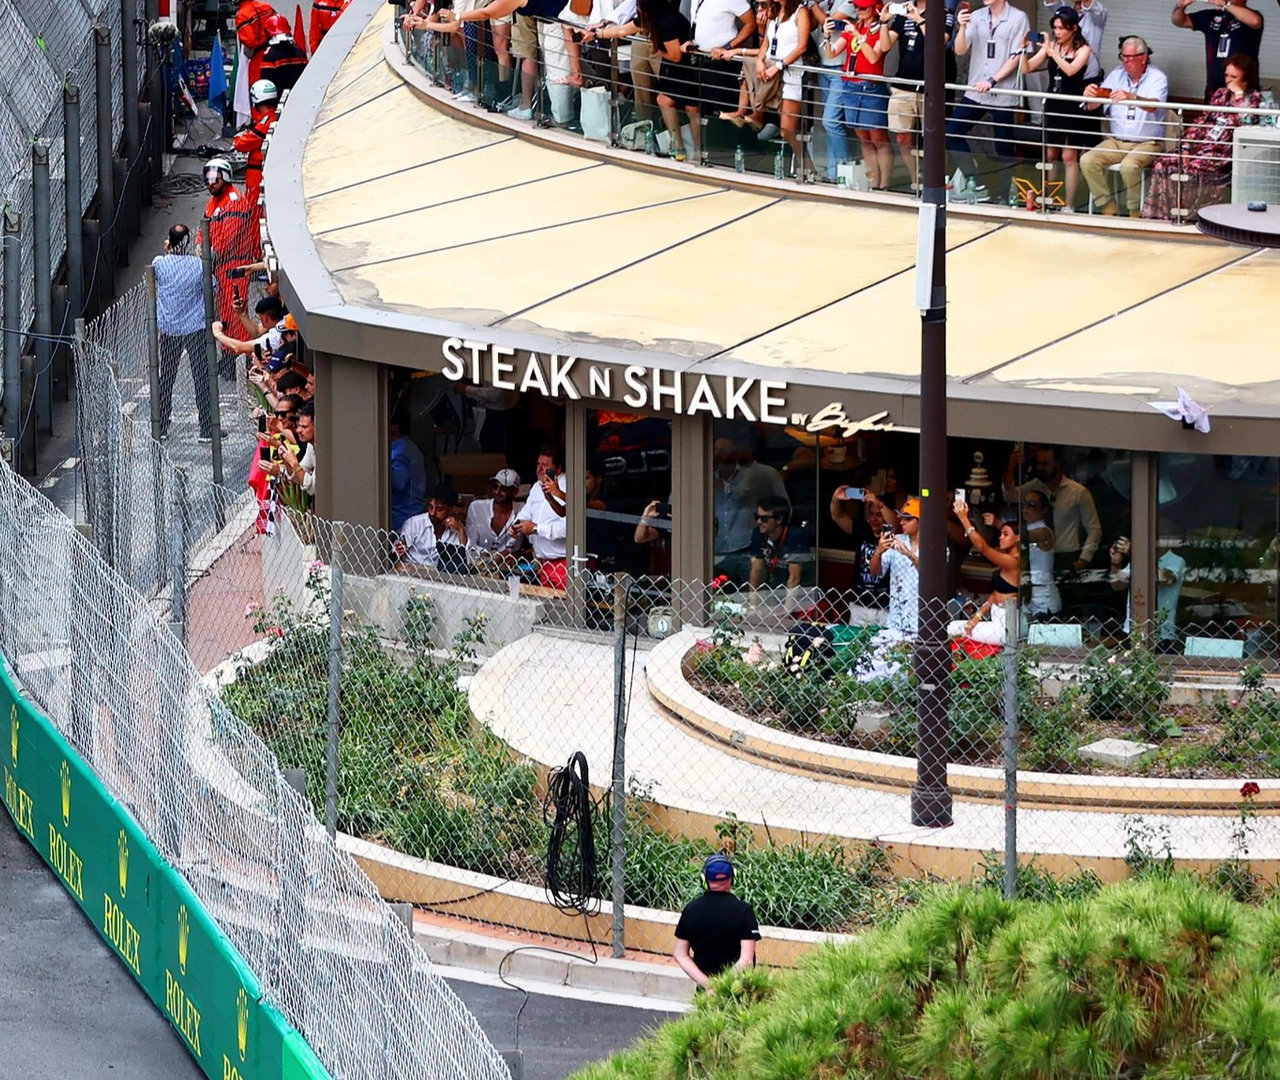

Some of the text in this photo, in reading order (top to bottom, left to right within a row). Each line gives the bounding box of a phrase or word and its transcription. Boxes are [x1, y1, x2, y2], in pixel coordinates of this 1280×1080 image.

[441, 337, 581, 401] STEAK
[588, 365, 611, 398] N
[624, 365, 787, 426] SHAKE
[791, 413, 809, 425] BY
[3, 766, 35, 839] ROLEX
[48, 822, 84, 901] ROLEX
[103, 892, 141, 976] ROLEX
[165, 968, 202, 1056] ROLEX
